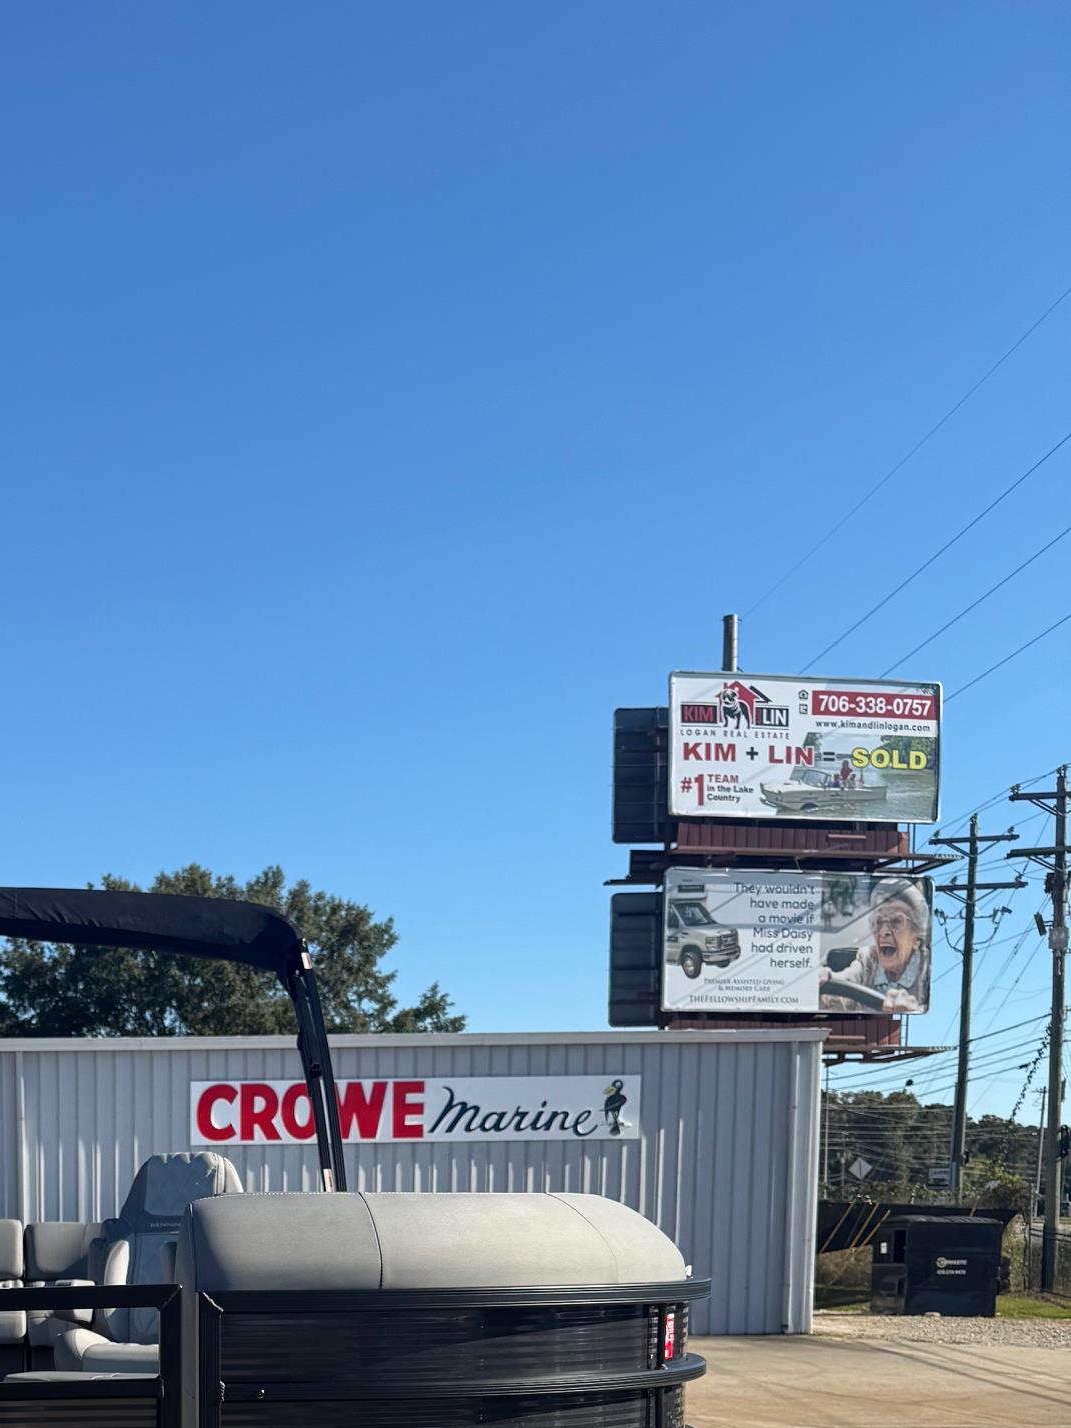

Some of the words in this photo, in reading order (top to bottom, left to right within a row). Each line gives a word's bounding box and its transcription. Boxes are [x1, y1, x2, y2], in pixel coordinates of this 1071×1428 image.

[818, 695, 931, 716] 706-338-0757
[684, 705, 714, 722] KIM
[763, 708, 787, 725] LIN
[815, 720, 930, 732] www.kimandlinlogan.com
[680, 729, 716, 737] LOGAN
[723, 730, 748, 738] REAL
[755, 732, 790, 740] ESTATE
[683, 742, 736, 762] KIM
[746, 746, 759, 760] +
[769, 745, 813, 765] LIN
[851, 747, 927, 770] SOLD
[707, 774, 739, 784] TEAM
[717, 785, 731, 793] the
[734, 785, 754, 794] Lake
[707, 793, 741, 804] Country
[733, 882, 762, 896] They
[765, 884, 815, 895] wouldn't
[750, 897, 779, 909] have
[781, 899, 814, 910] made
[758, 915, 766, 923] a
[769, 913, 803, 924] movie
[806, 912, 815, 924] if
[753, 927, 778, 938] Miss
[782, 927, 814, 942] Daisy
[751, 942, 774, 953] had
[776, 942, 813, 954] driven
[769, 957, 813, 969] herself.
[196, 1081, 425, 1142] CROWE
[427, 1085, 602, 1137] Marine
